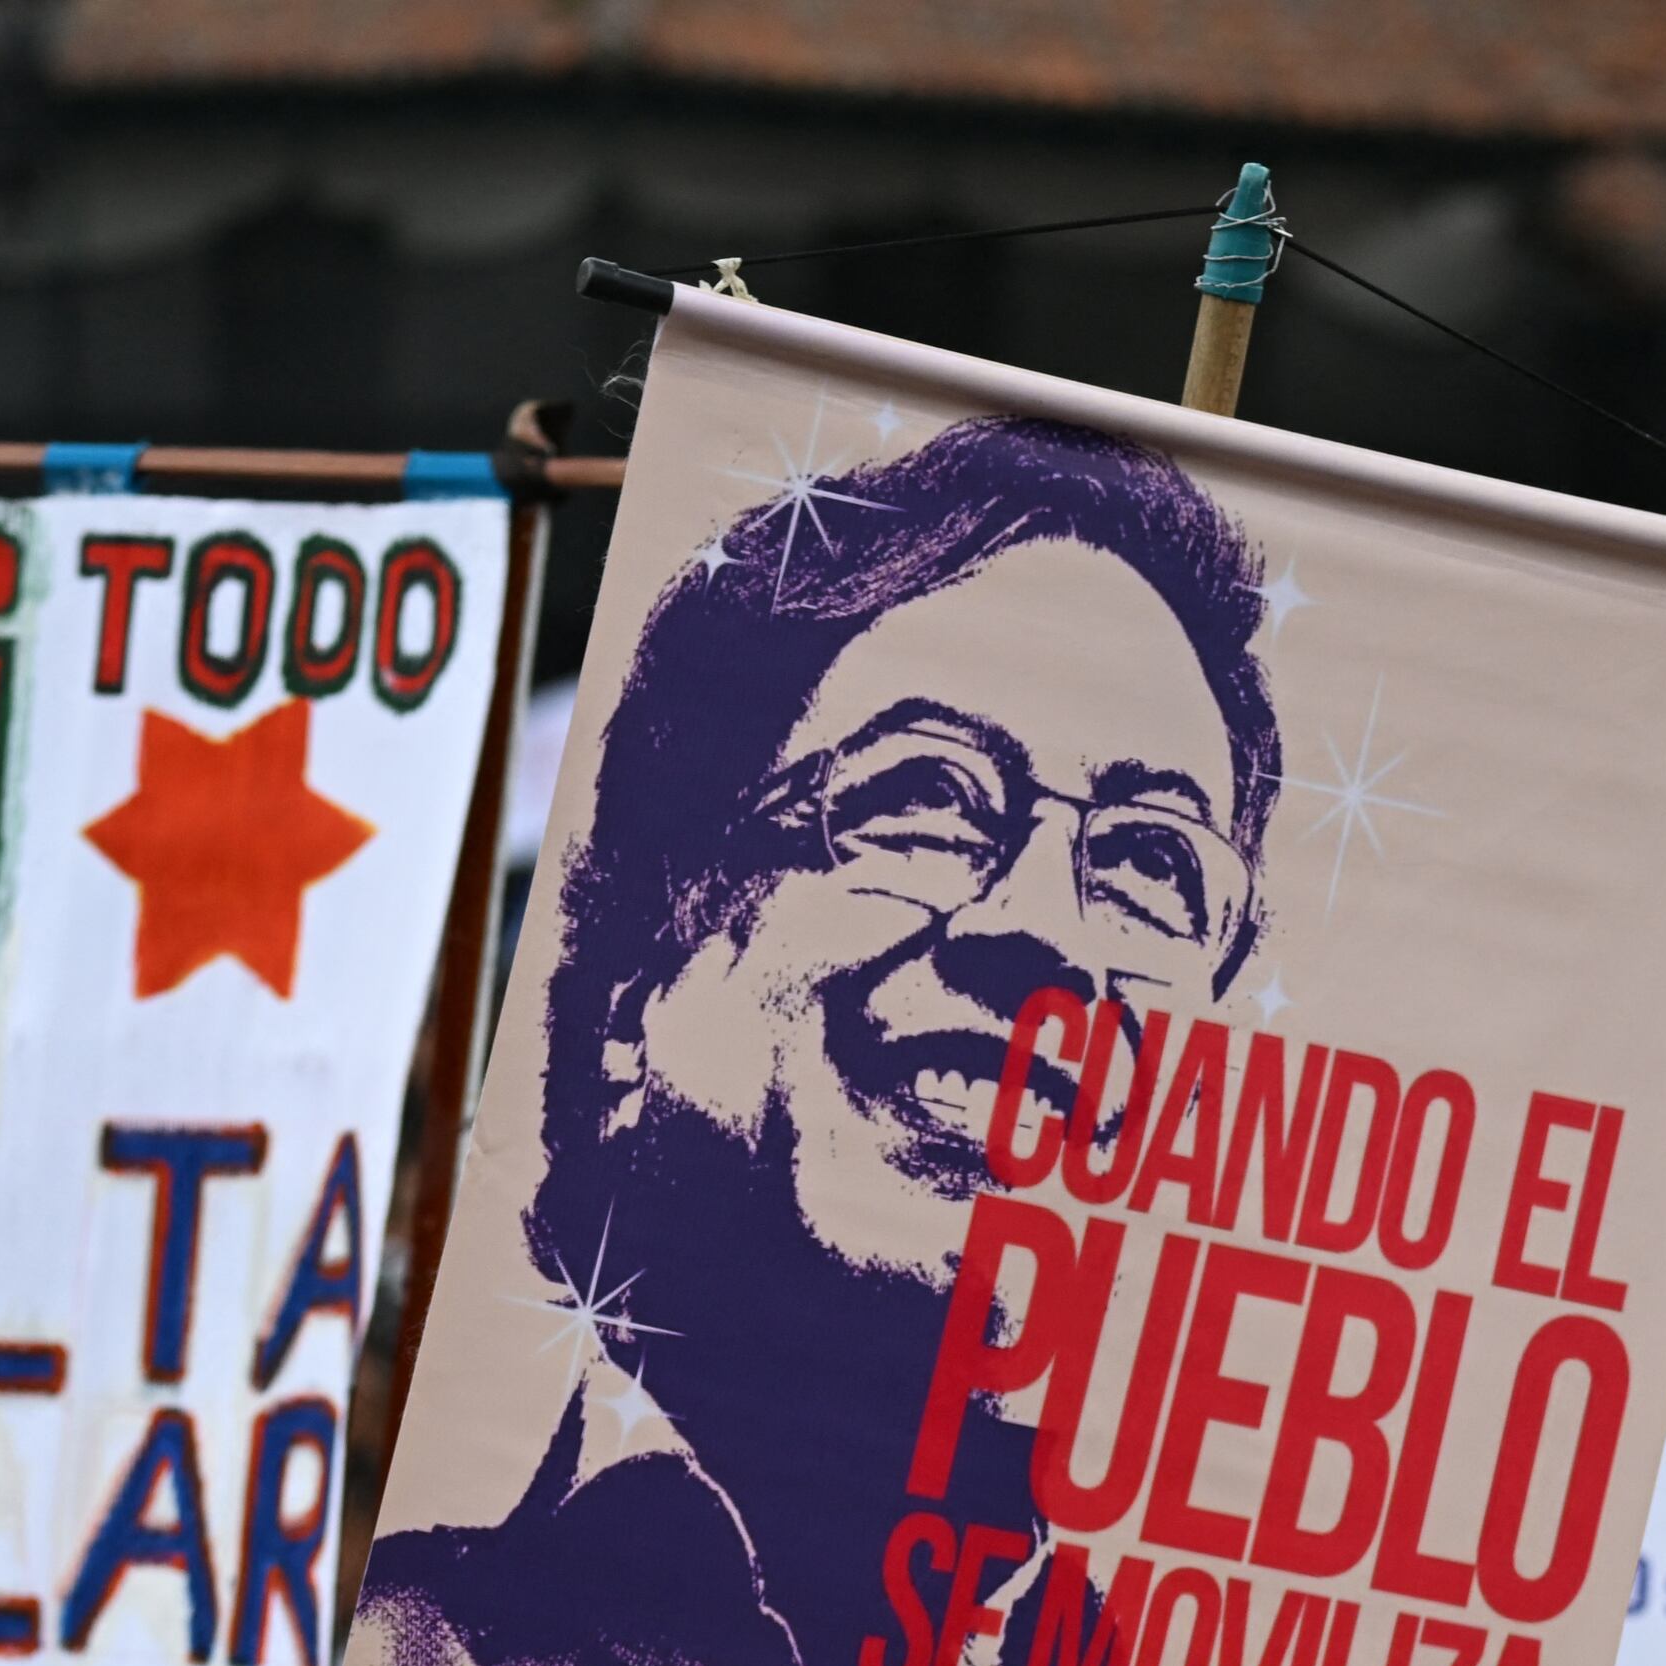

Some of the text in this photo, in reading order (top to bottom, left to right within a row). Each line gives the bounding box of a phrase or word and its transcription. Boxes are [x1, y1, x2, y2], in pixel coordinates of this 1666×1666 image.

[80, 531, 461, 712] TODO
[984, 985, 1627, 1310] CUANDO EL
[905, 1190, 1630, 1622] PUEBLO
